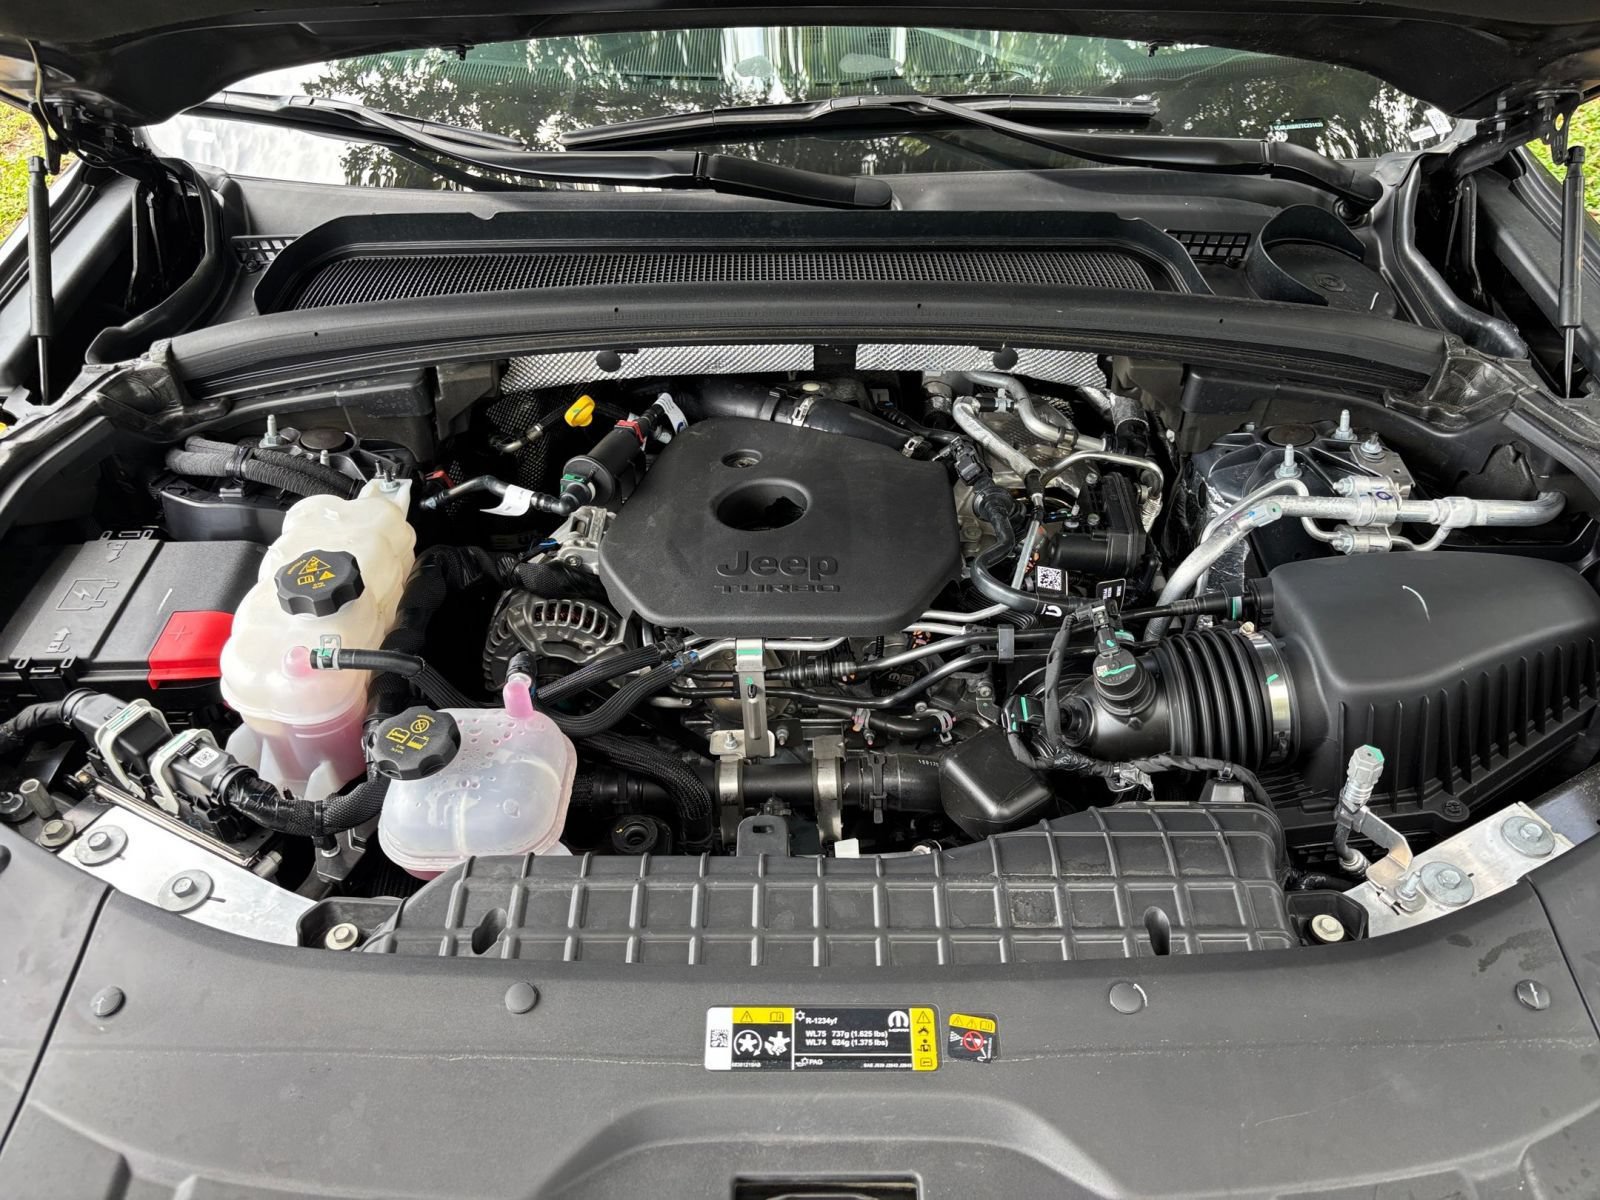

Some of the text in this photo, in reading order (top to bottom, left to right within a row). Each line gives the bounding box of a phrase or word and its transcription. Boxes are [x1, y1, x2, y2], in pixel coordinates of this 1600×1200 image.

[715, 551, 839, 582] Jeep
[714, 584, 840, 594] TURBO
[805, 1017, 838, 1026] R-1234yf
[831, 1030, 849, 1039] 737g
[874, 1030, 888, 1039] lbs)
[831, 1039, 850, 1047] 624g
[874, 1039, 888, 1047] lbs)
